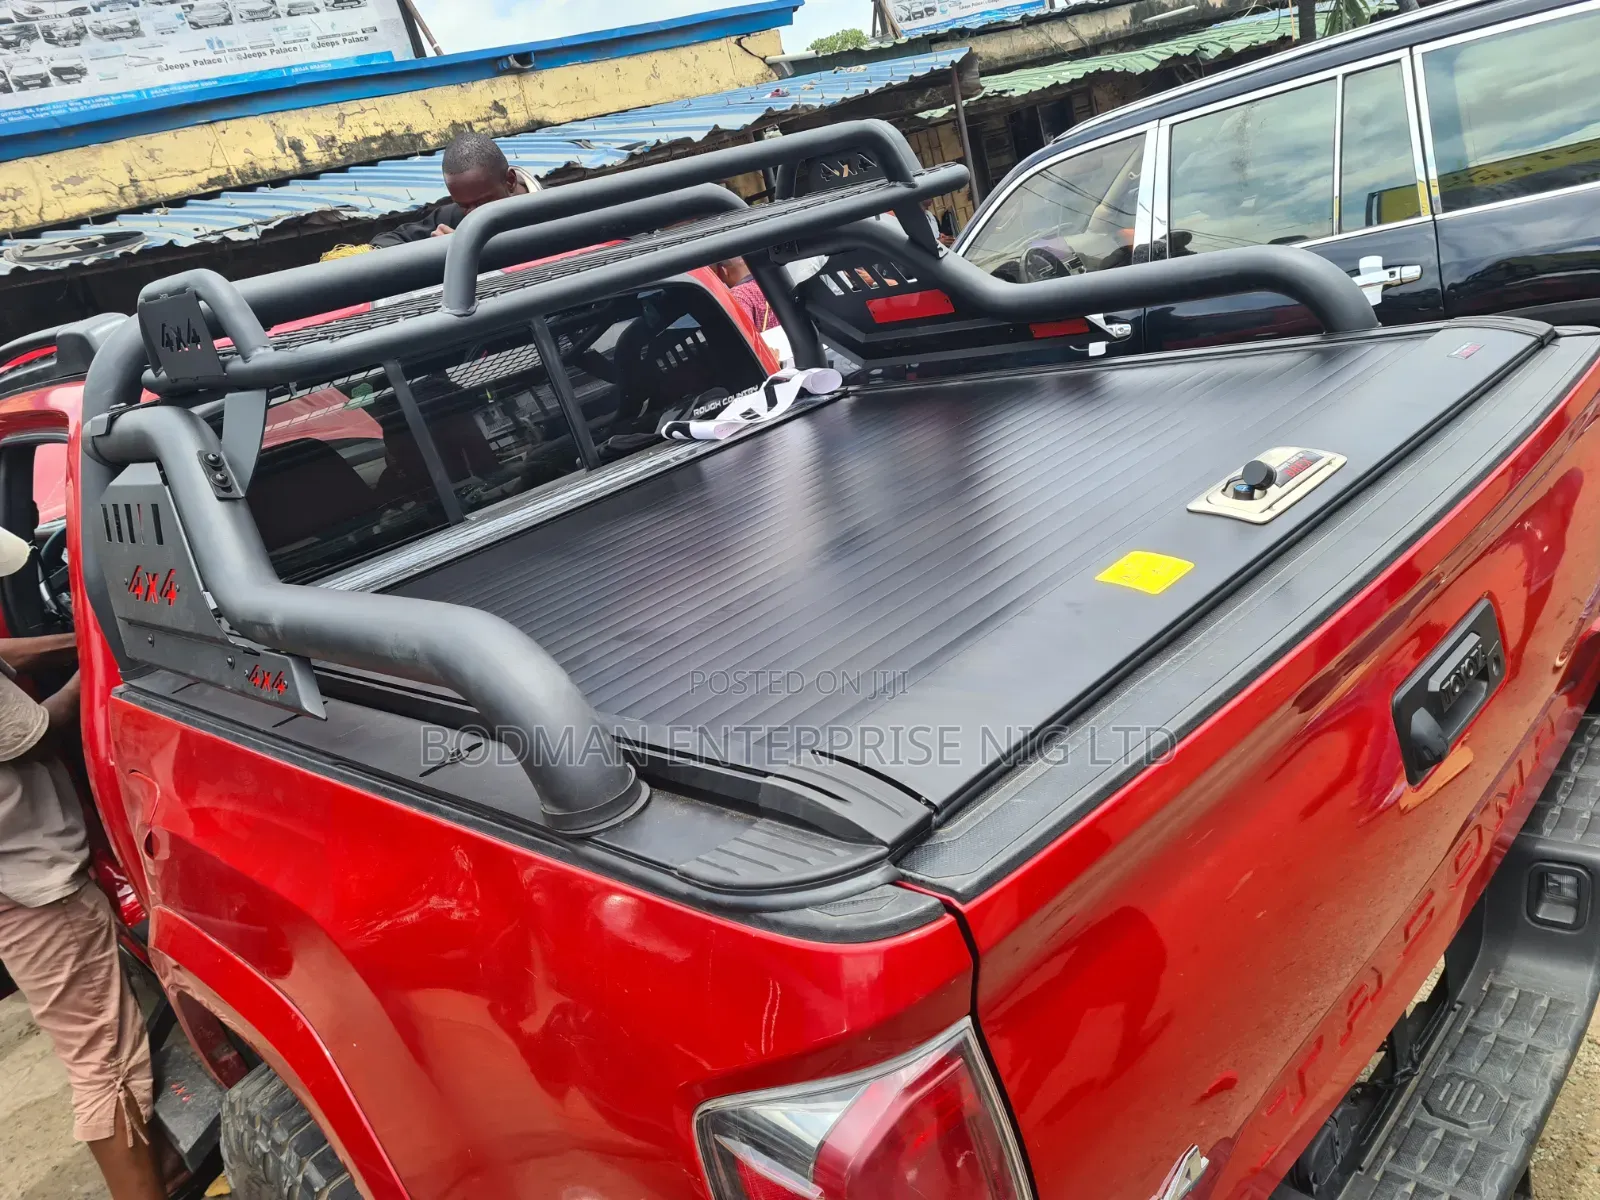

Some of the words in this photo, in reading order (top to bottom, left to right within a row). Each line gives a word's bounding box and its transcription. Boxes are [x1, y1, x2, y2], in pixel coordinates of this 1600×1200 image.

[342, 36, 369, 45] Palace
[270, 46, 298, 55] Palace
[193, 56, 222, 67] Palace
[693, 400, 723, 416] ROUGH
